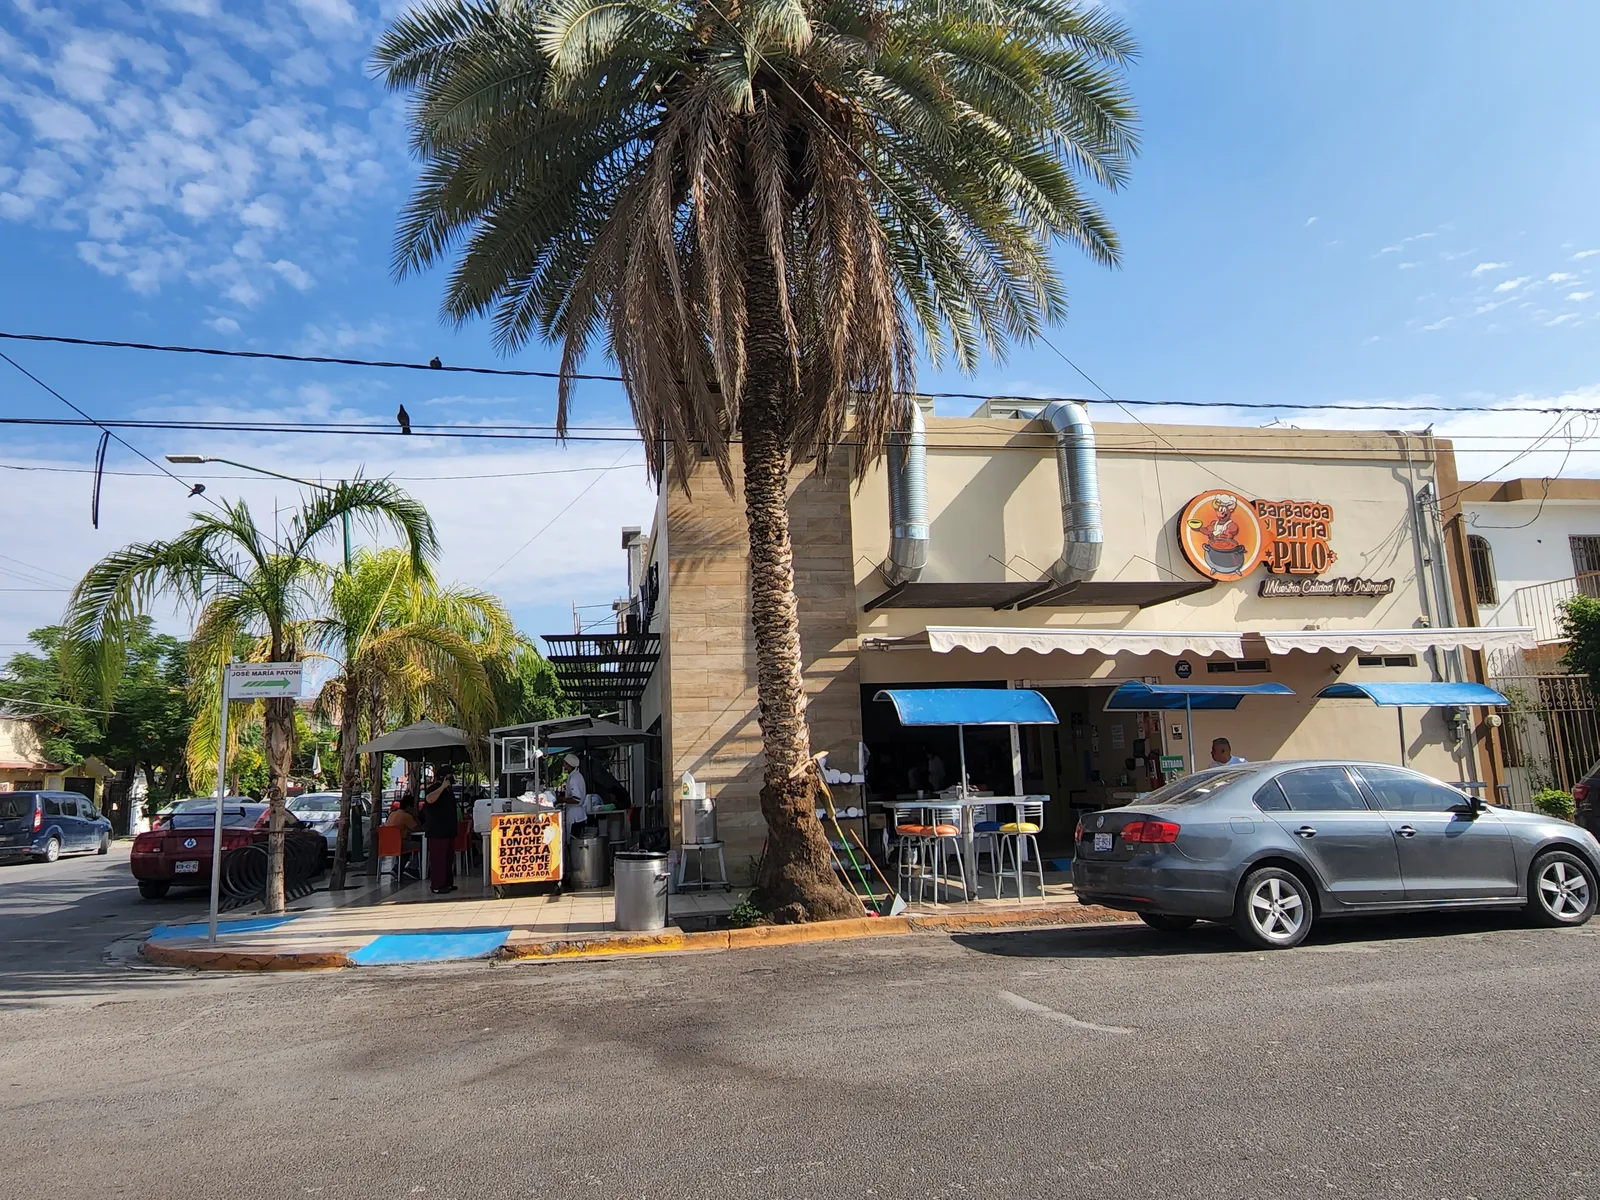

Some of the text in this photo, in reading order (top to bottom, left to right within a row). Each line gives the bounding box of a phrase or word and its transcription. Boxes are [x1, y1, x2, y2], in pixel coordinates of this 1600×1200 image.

[1276, 518, 1327, 538] Birria
[1273, 541, 1326, 570] PILO
[1302, 579, 1334, 593] Calidad
[1335, 579, 1351, 592] Nos
[1162, 759, 1183, 768] ENTRADA
[501, 836, 548, 846] LONCHE
[499, 845, 551, 857] BIRRIA
[500, 854, 550, 865] CONSOME
[499, 863, 550, 873] TACOS DE
